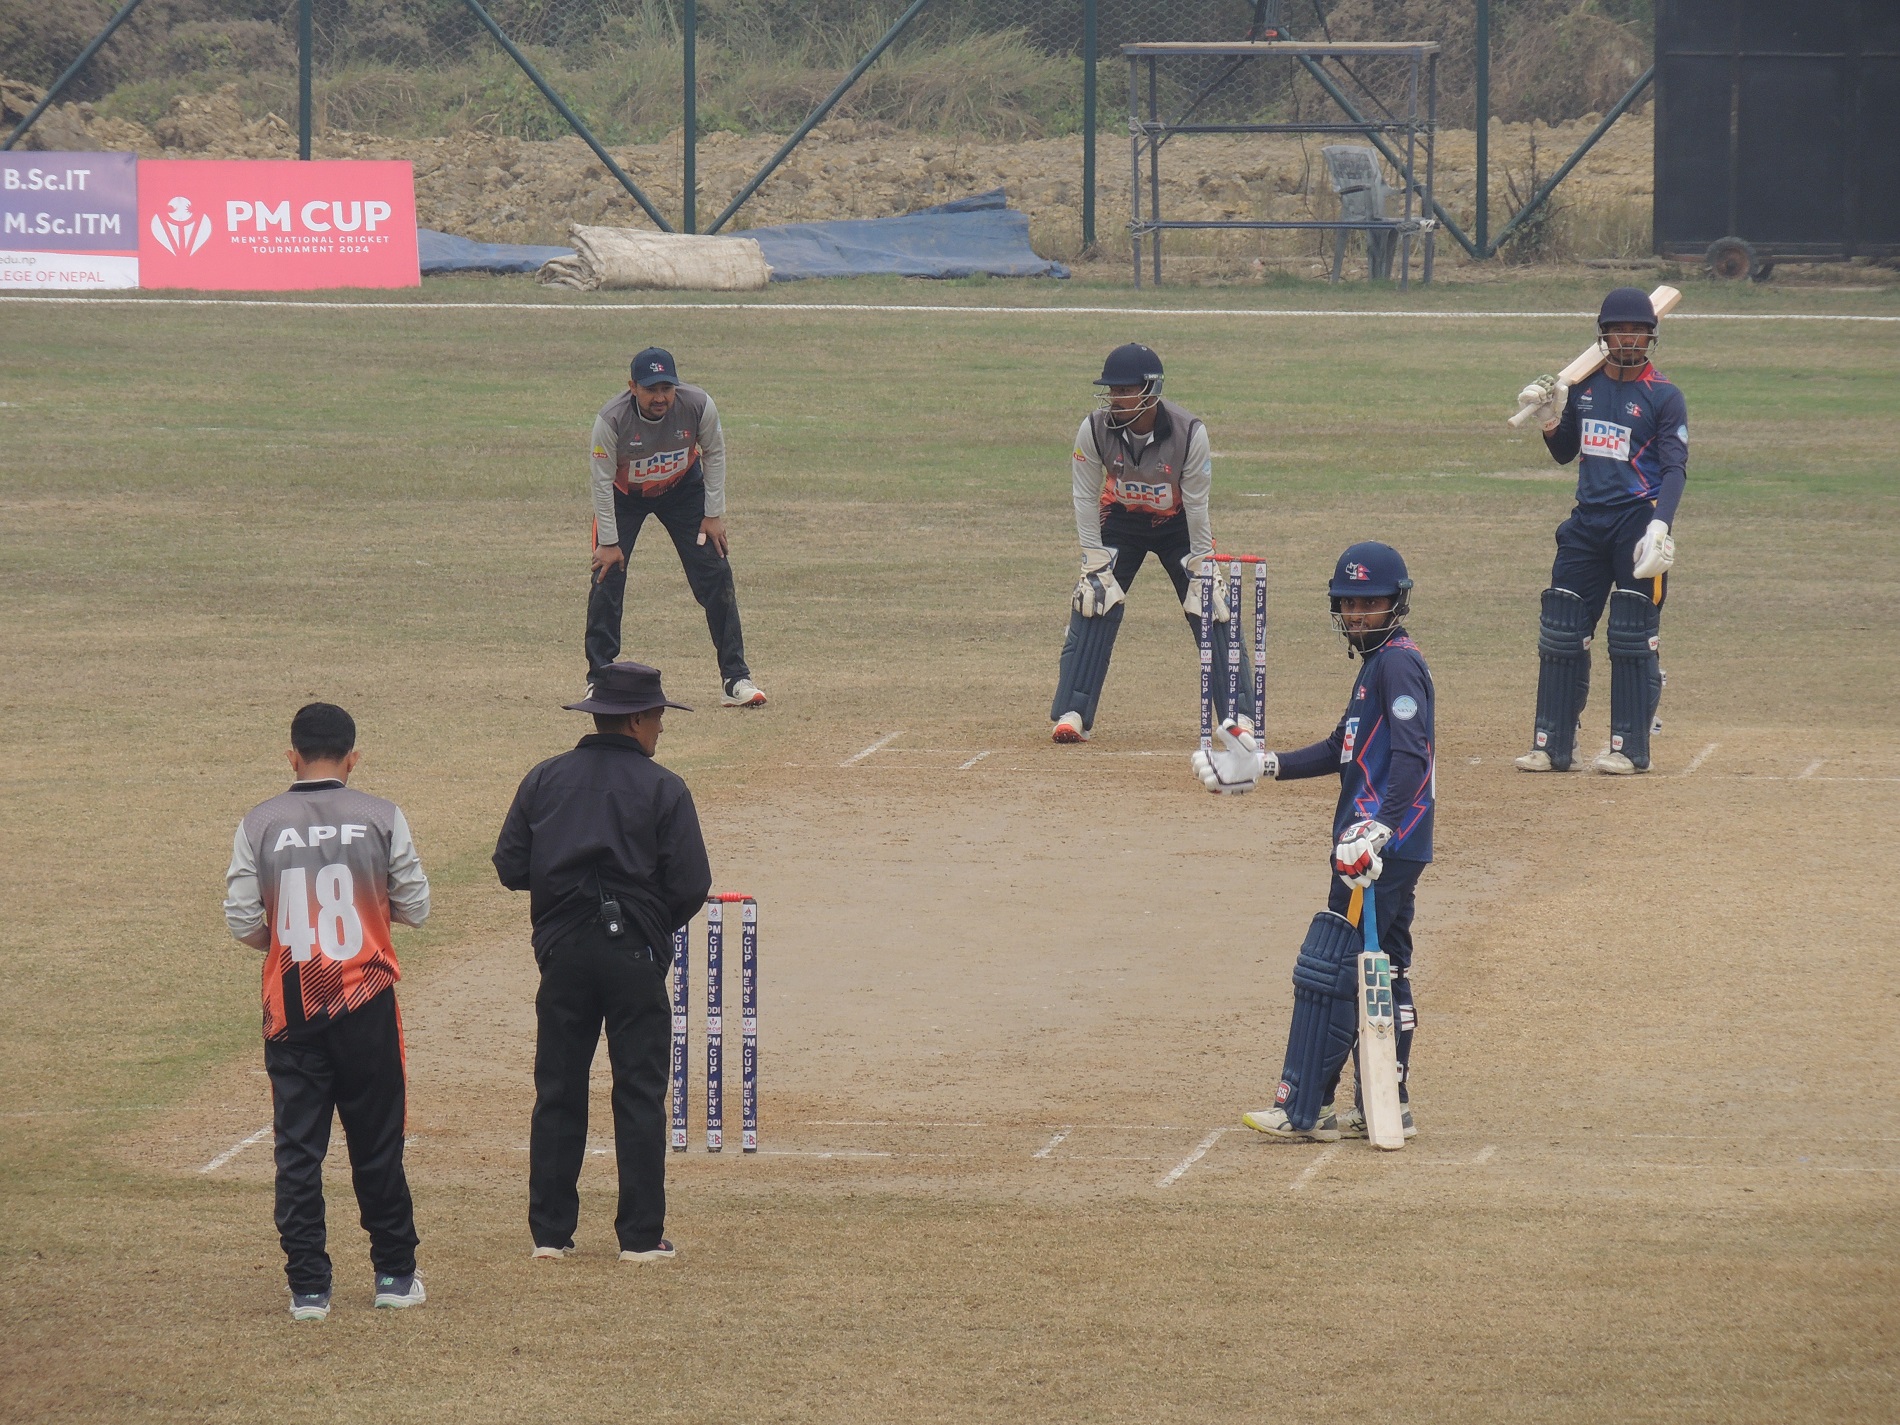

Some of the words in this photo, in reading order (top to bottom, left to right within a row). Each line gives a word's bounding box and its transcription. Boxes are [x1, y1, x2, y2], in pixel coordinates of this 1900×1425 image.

[4, 168, 91, 191] B.Sc.IT
[5, 212, 120, 235] M.Sc.ITM
[226, 200, 291, 232] PM
[301, 200, 392, 232] CUP
[231, 236, 269, 244] MEN'S
[275, 236, 334, 244] NATIONAL
[339, 236, 389, 244] CRICKET
[252, 246, 334, 254] TOURNAMENT
[339, 245, 369, 253] 2024
[36, 271, 56, 281] OF
[60, 271, 105, 282] NEPAL
[1202, 612, 1210, 638] MEN'S
[1230, 612, 1238, 638] MEN'S
[1202, 699, 1210, 725] MEN'S
[1255, 700, 1263, 727] MEN'S
[274, 824, 367, 852] APF
[277, 864, 363, 961] 48
[744, 937, 752, 963] CUP
[674, 967, 683, 1002] MEN'S
[708, 968, 719, 1003] MEN'S
[743, 969, 753, 1003] MEN'S
[1364, 958, 1392, 1017] SS
[744, 1049, 752, 1075] CUP
[674, 1079, 683, 1114] MEN'S
[709, 1081, 719, 1115] MEN'S
[743, 1081, 753, 1116] MEN'S
[380, 1277, 394, 1286] NB
